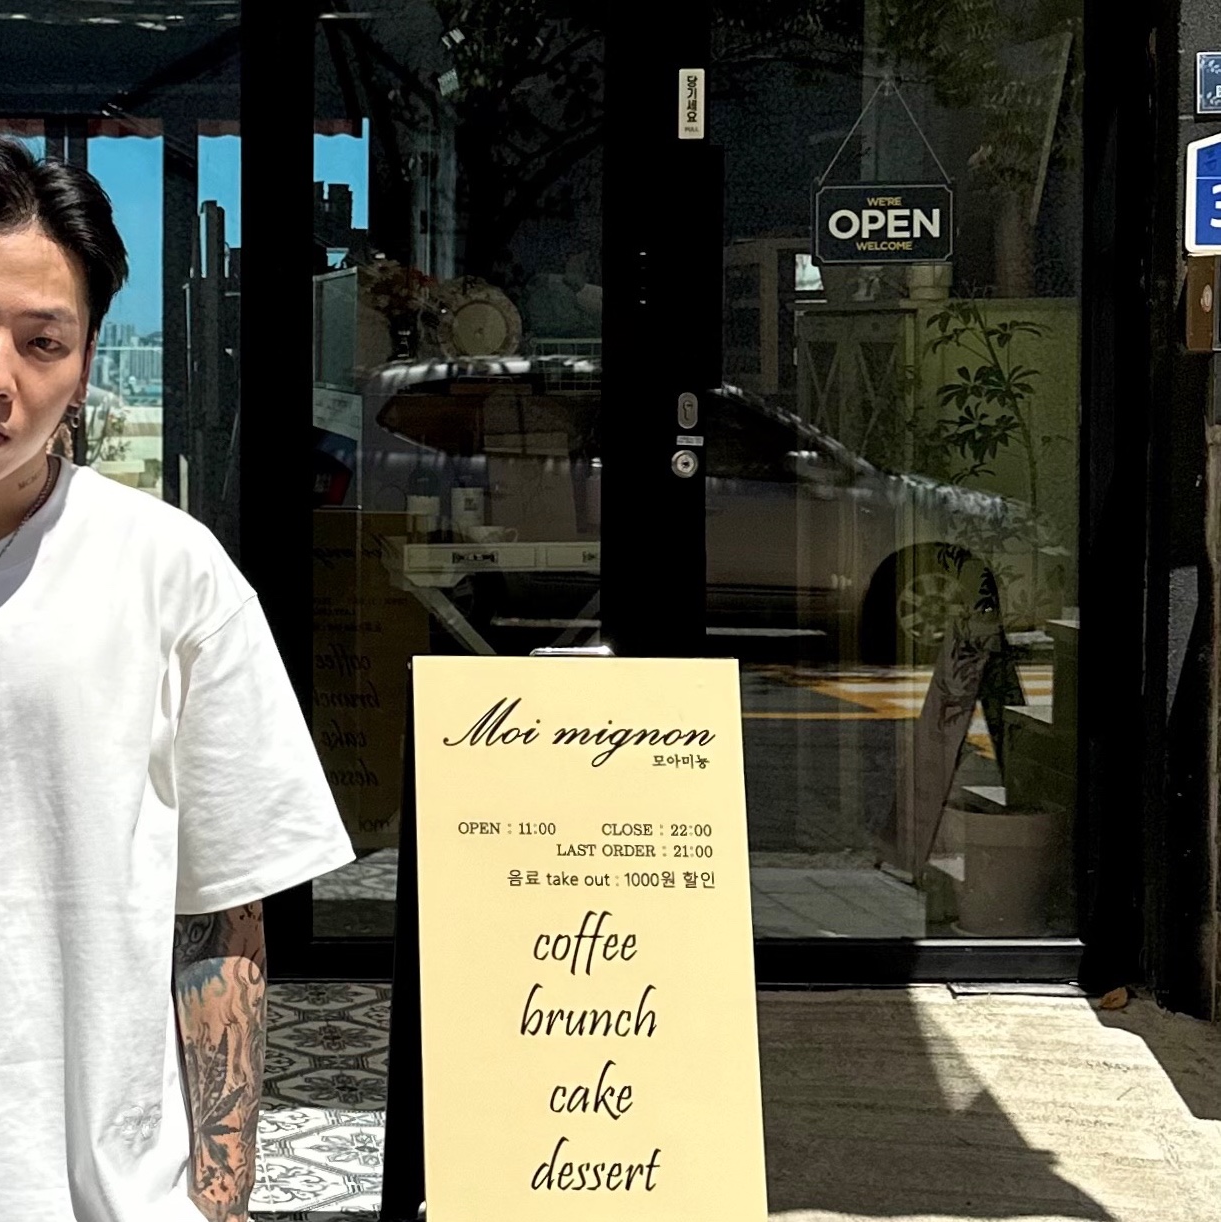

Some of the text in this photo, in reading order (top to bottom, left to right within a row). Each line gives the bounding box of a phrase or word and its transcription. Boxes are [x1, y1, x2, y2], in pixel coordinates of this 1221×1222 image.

[686, 75, 698, 123] 당기세요
[828, 209, 940, 239] OPEN
[856, 241, 913, 250] WELCOME
[443, 697, 716, 767] Moi mignon
[458, 822, 501, 835] OPEN
[519, 822, 557, 835] 11:00
[601, 823, 653, 836] CLOSE
[671, 824, 712, 837] 22:00
[556, 844, 597, 857] LAST
[602, 844, 656, 857] ORDER
[674, 845, 713, 858] 21:00
[507, 869, 541, 887] 음료
[546, 871, 579, 886] take
[584, 873, 610, 886] out
[624, 871, 676, 888] 1000원
[682, 871, 716, 889] 할인
[533, 910, 638, 976] coffee
[520, 983, 658, 1038] brunch
[549, 1060, 634, 1121] cake
[531, 1136, 662, 1192] dessert
